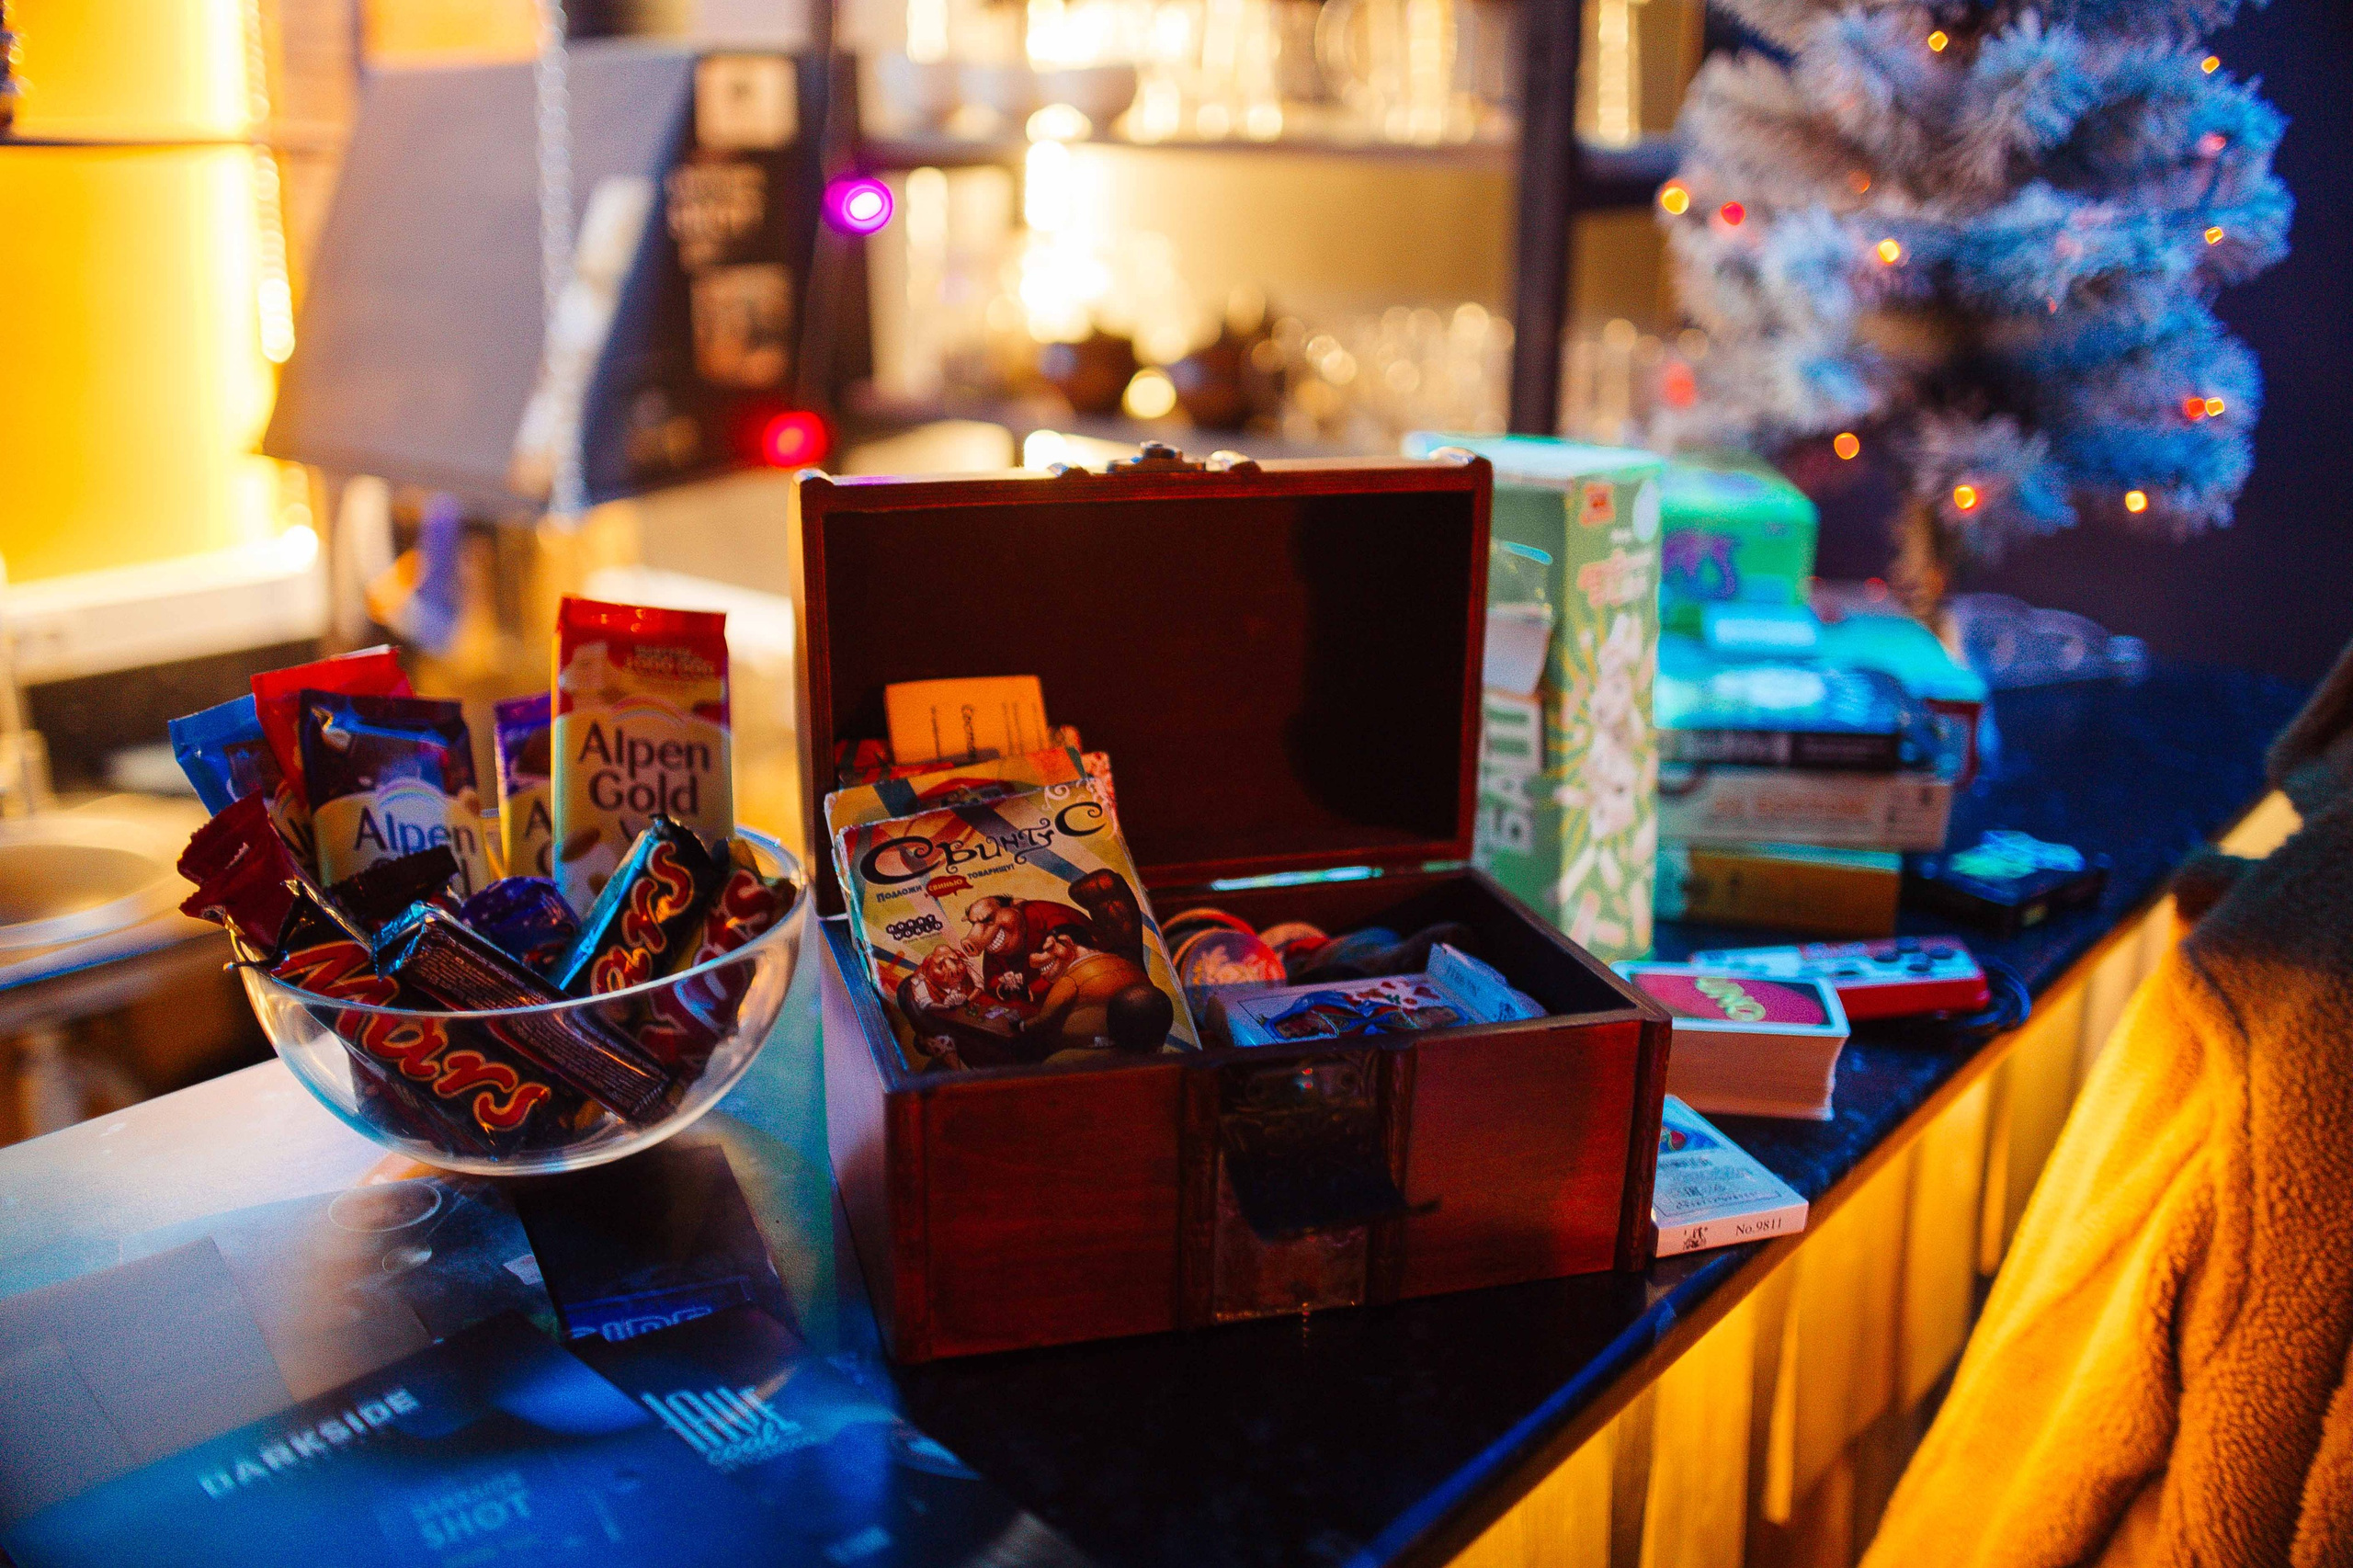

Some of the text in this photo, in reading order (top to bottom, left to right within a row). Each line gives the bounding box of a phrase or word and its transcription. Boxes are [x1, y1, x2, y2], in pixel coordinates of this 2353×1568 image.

[579, 721, 710, 780] Alpen
[588, 771, 699, 816] Gold
[353, 806, 477, 856] Alpen
[591, 840, 694, 995] ars
[887, 915, 936, 935] HOBBY
[892, 922, 943, 940] WORLD
[268, 939, 551, 1132] Mars
[1735, 1216, 1782, 1237] No.9811
[198, 1384, 420, 1499] DARKSIDE
